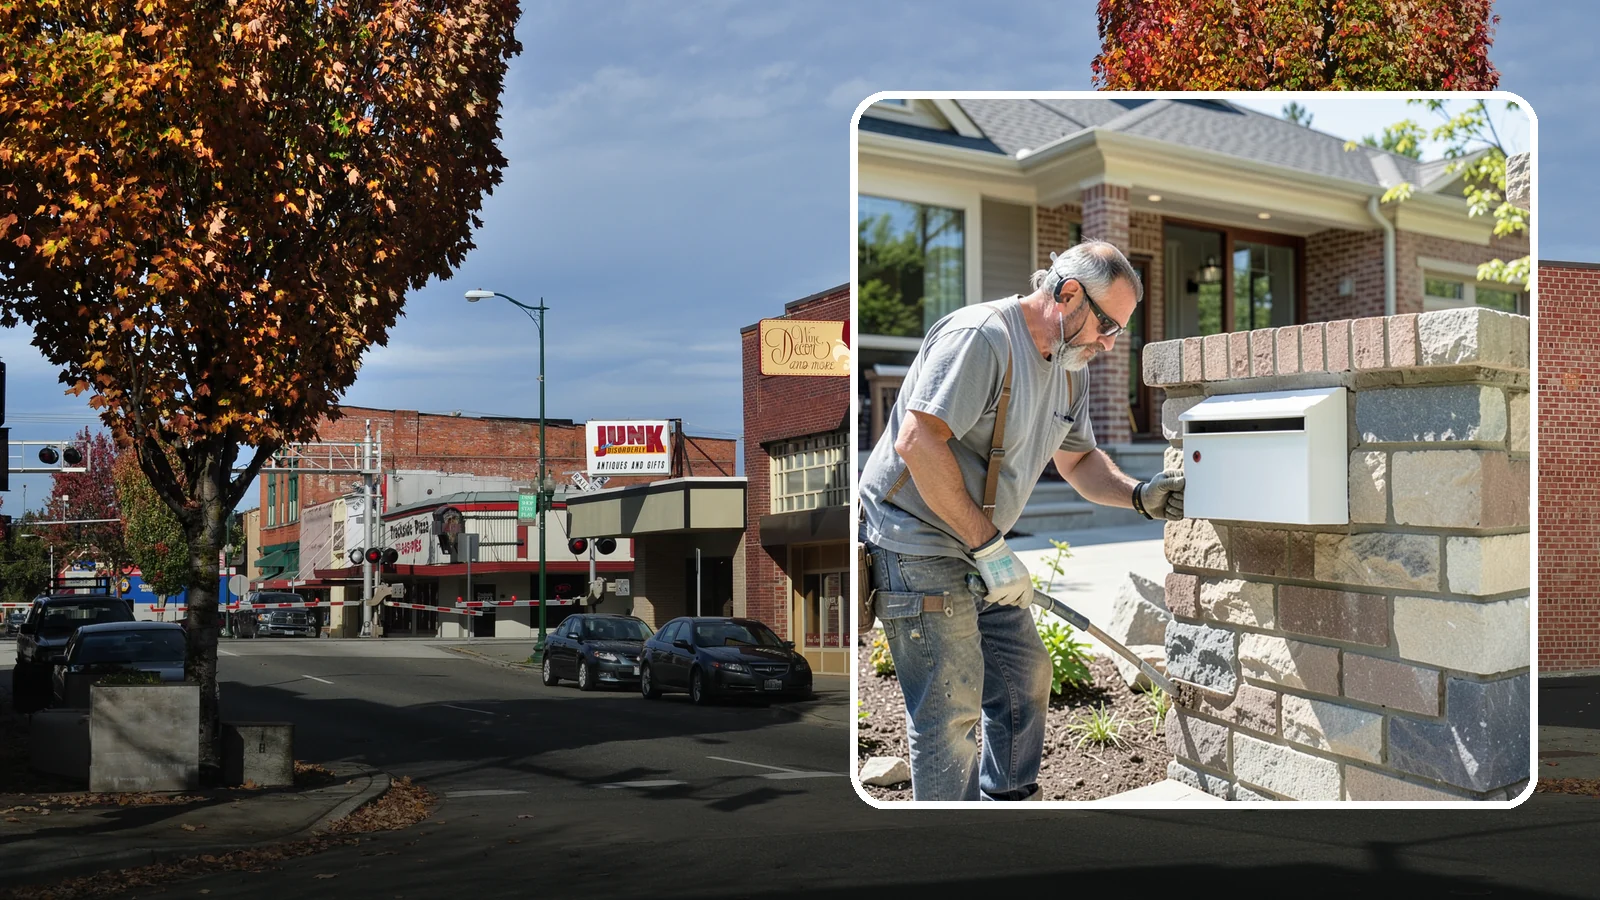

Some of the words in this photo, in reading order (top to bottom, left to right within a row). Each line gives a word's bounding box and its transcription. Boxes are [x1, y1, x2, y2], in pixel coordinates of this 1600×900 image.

[765, 328, 831, 365] Decor
[595, 425, 665, 457] JUNK
[607, 446, 646, 454] DISORDERLY
[597, 461, 628, 470] ANTIQUES
[631, 461, 644, 470] AND
[647, 460, 665, 469] GIFTS
[414, 519, 429, 535] Pizza
